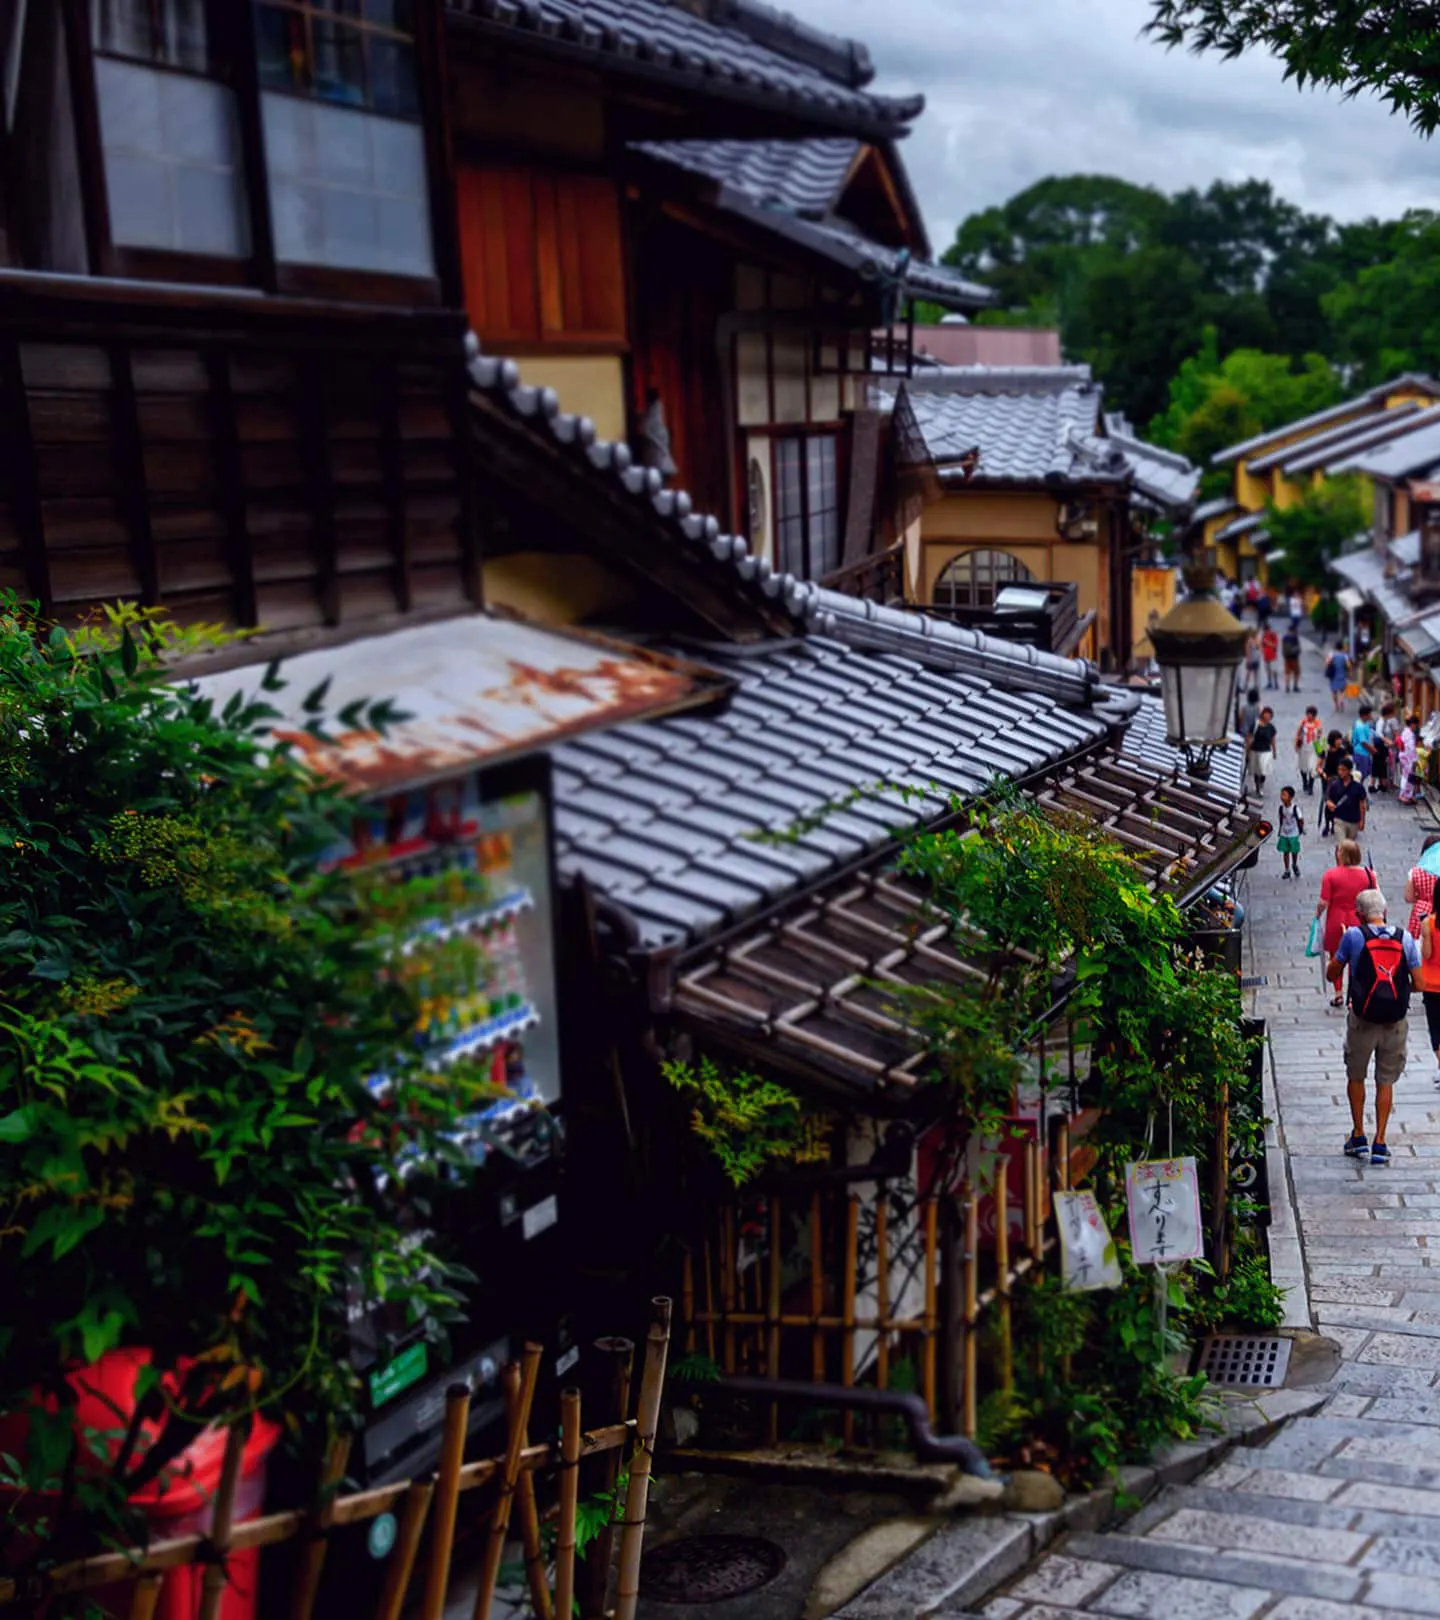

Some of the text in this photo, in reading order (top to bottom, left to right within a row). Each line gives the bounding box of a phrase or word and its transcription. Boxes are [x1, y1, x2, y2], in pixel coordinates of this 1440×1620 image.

[1143, 1179, 1176, 1261] すべります
